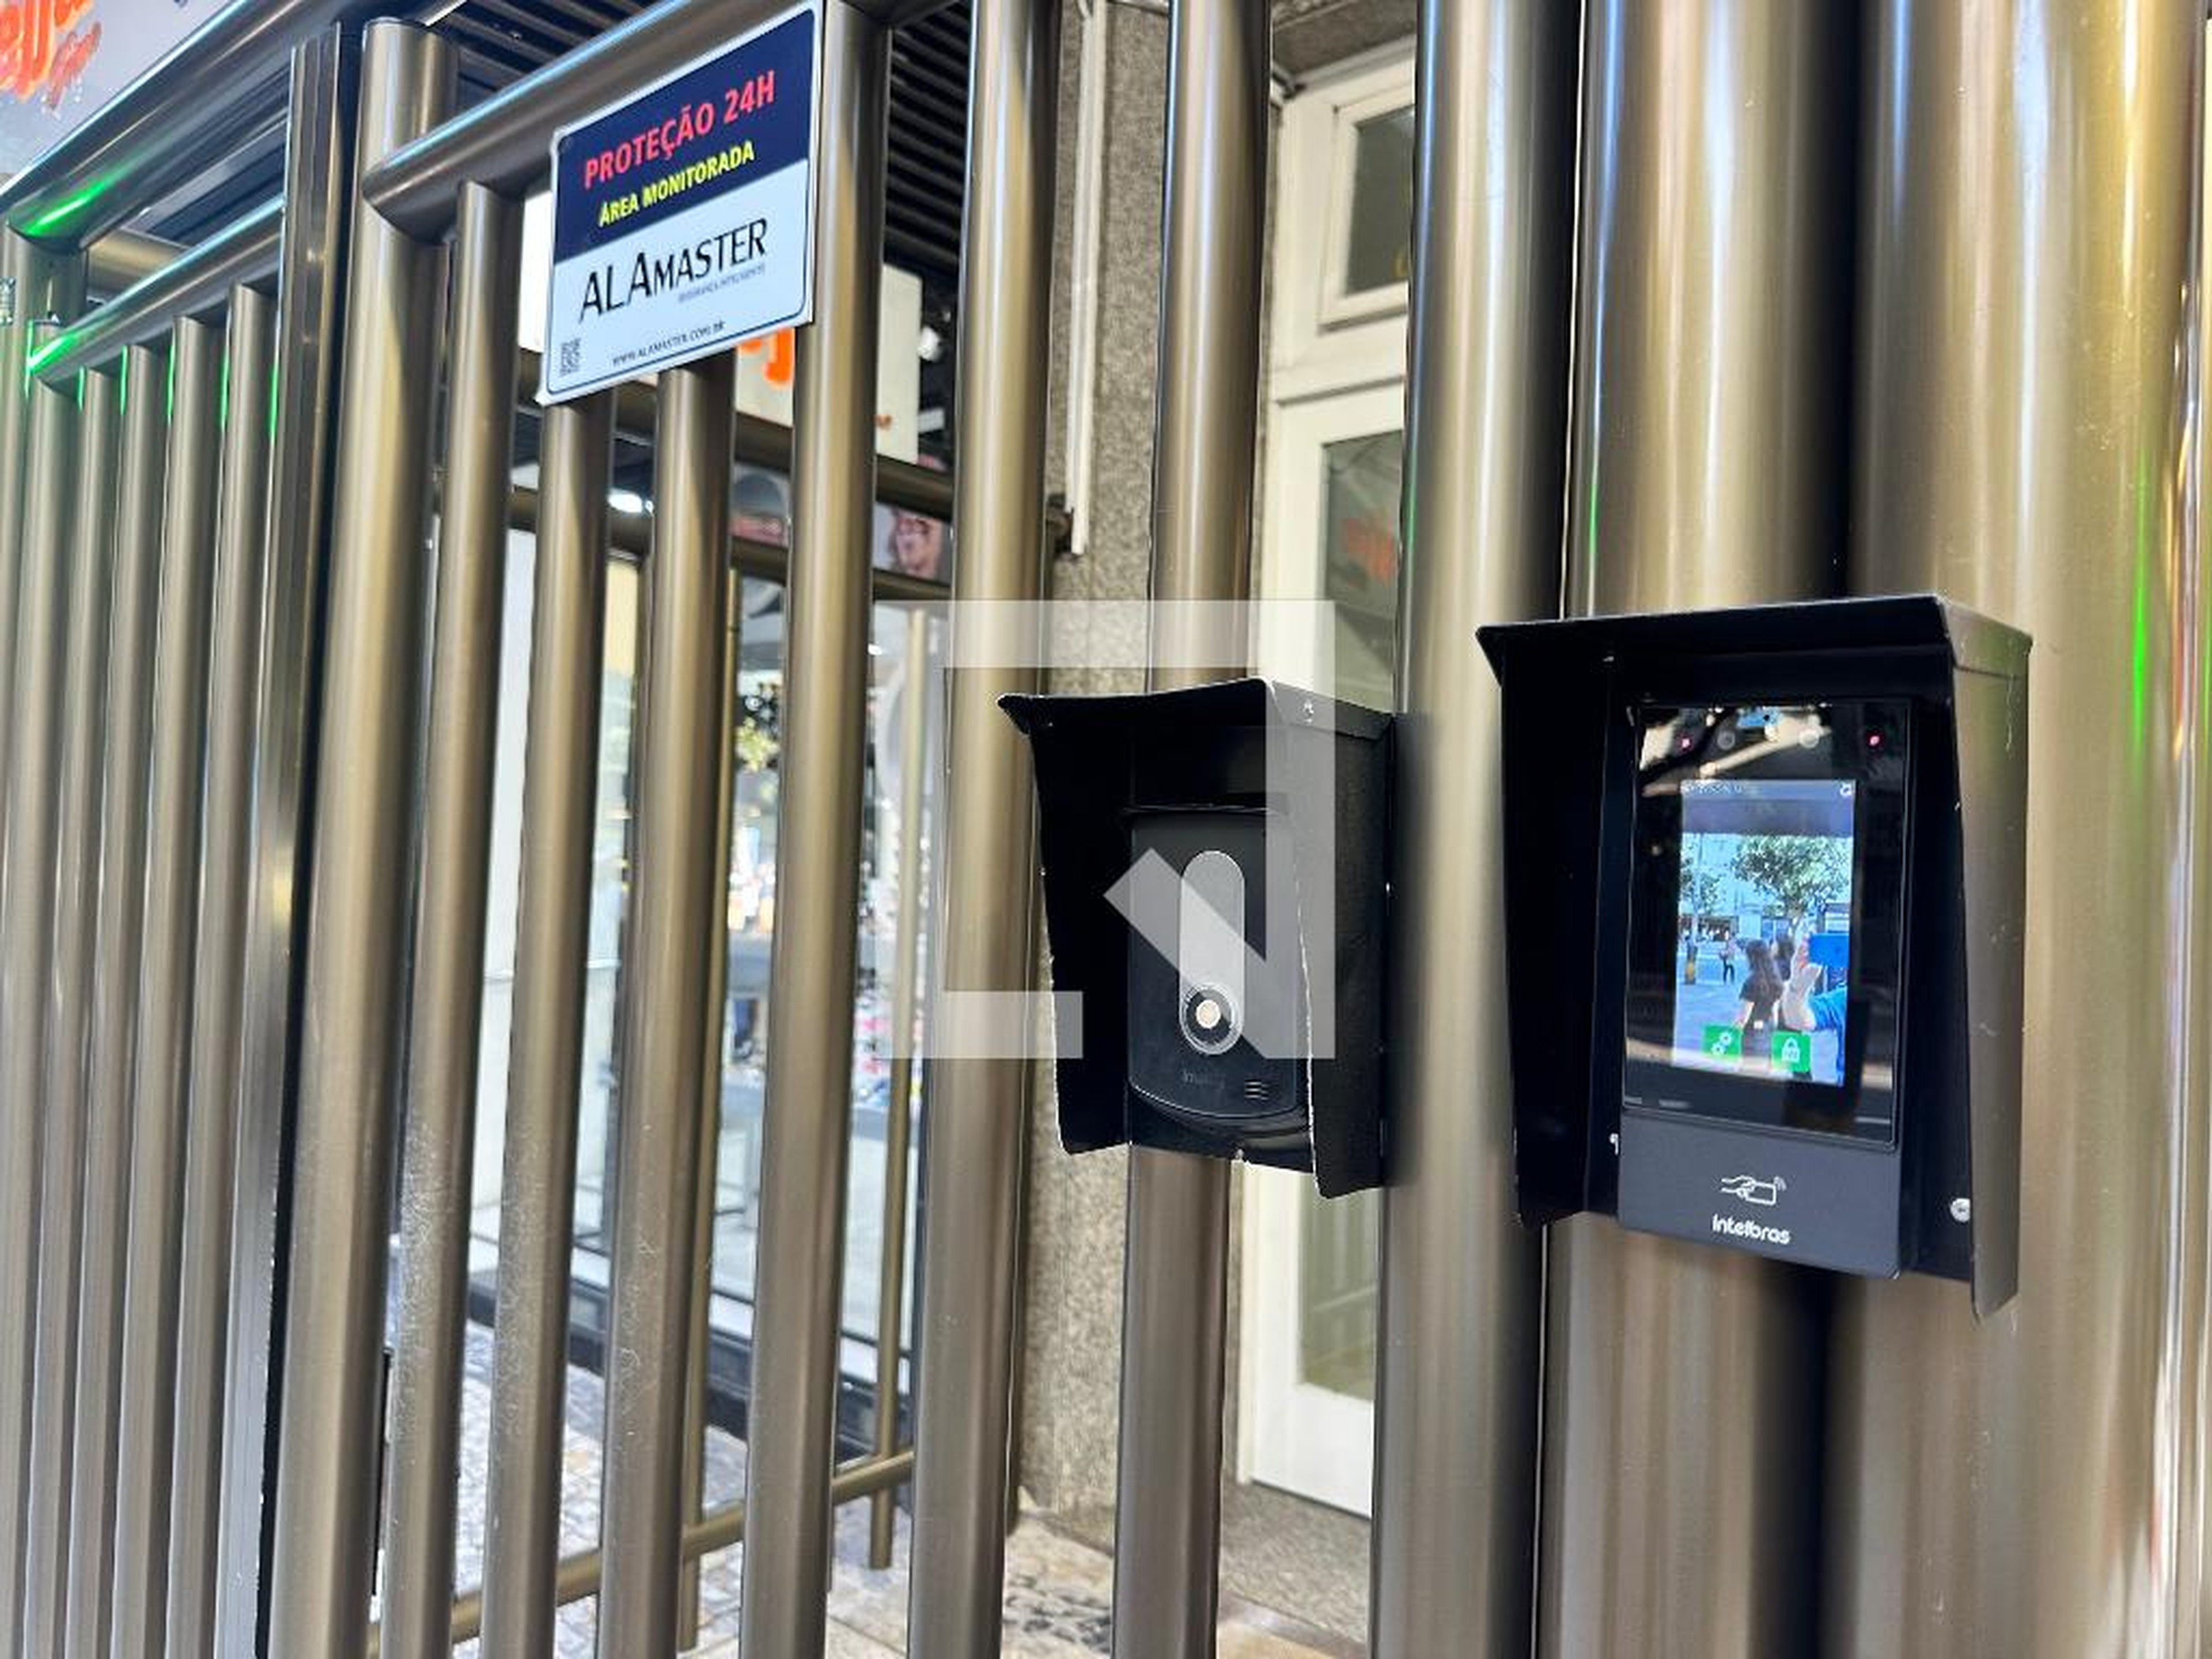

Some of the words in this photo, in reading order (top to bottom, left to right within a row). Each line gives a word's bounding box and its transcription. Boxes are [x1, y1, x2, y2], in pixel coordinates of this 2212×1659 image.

[584, 103, 715, 189] PROTEÇÃO
[724, 70, 775, 124] 24H
[599, 194, 639, 228] ÁREA
[642, 140, 755, 209] MONITORADA
